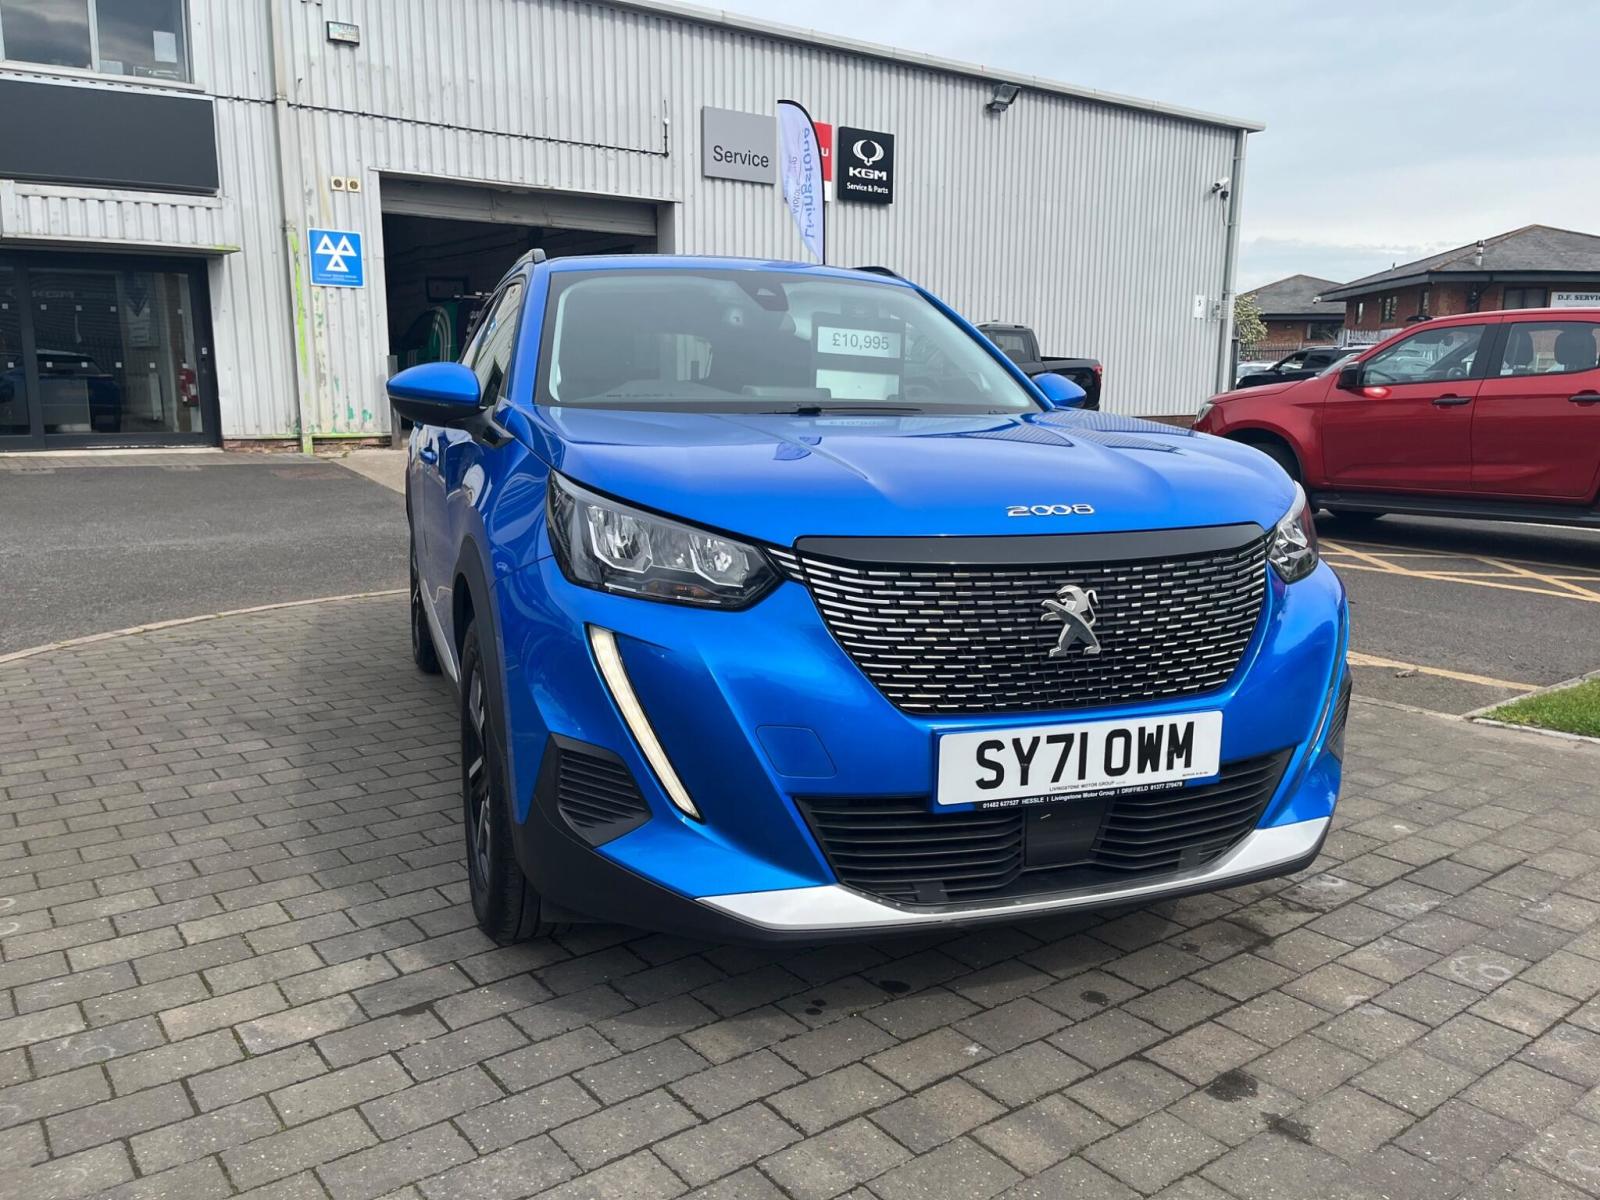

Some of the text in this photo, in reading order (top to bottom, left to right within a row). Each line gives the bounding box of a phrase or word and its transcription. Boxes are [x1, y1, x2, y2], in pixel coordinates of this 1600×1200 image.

[713, 145, 769, 168] Service
[848, 166, 887, 181] KGM
[846, 181, 868, 192] Service
[874, 185, 889, 194] Parts
[832, 332, 889, 351] £10,995
[1006, 503, 1095, 517] 2008
[975, 721, 1195, 790] SY71 OWM
[1021, 796, 1045, 805] HESSLE
[1051, 793, 1082, 802] Livingstone
[1121, 785, 1149, 794] DRIFFIELD
